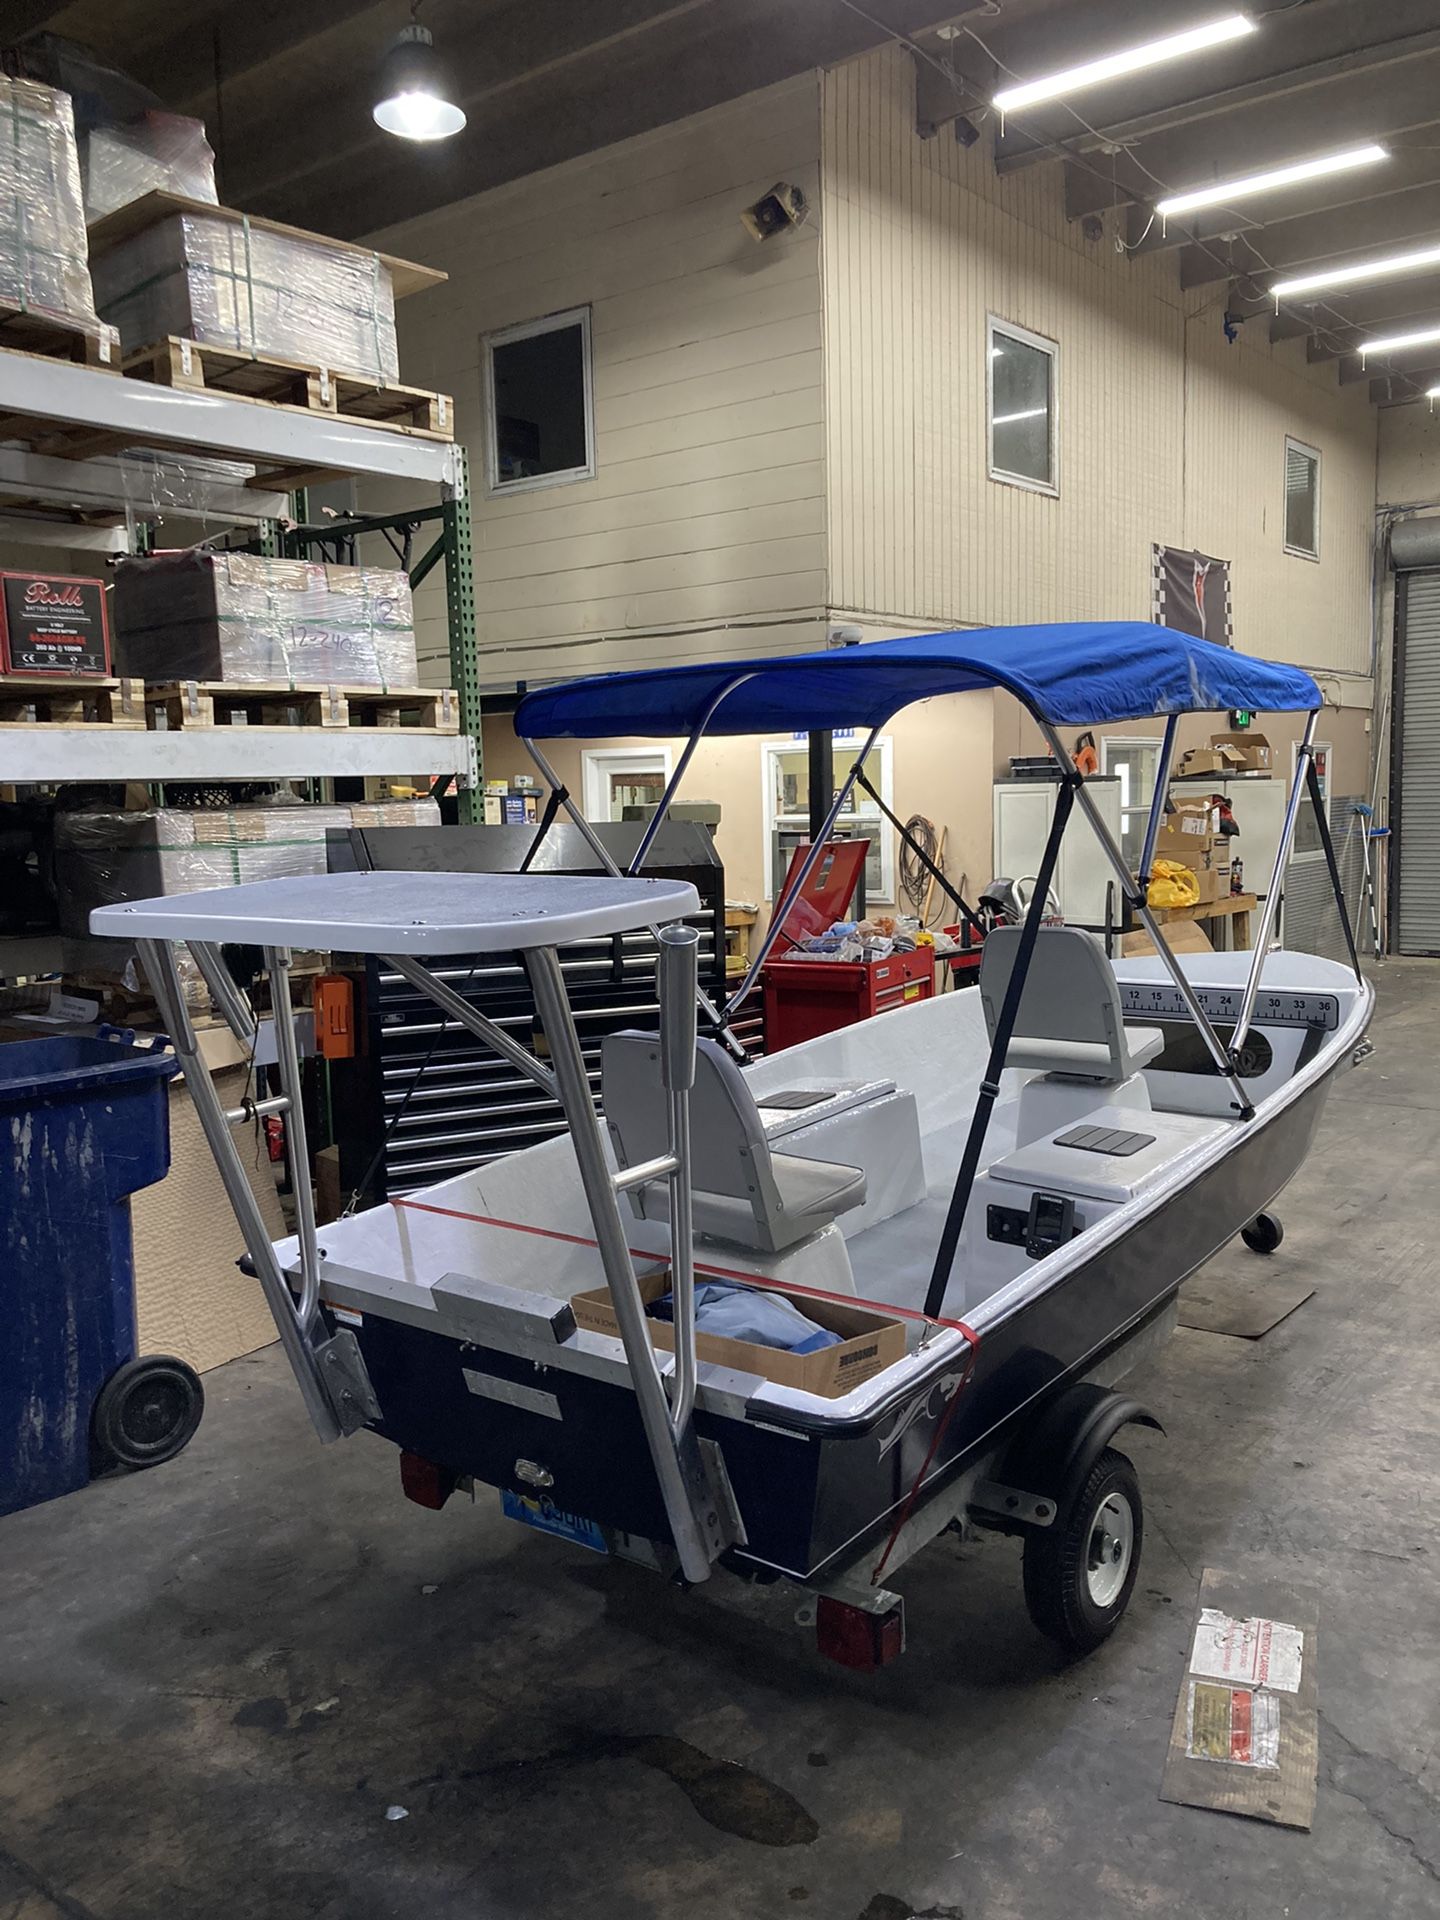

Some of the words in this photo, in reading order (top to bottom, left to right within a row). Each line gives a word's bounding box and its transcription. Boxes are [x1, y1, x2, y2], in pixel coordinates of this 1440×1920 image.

[24, 582, 84, 606] Rolls
[49, 606, 85, 615] ENGINEERING
[1128, 990, 1140, 999] 12
[1151, 991, 1162, 1001] 15
[1198, 994, 1208, 1003] 21
[1220, 995, 1232, 1005] 24
[1268, 998, 1281, 1007] 30
[1293, 1000, 1306, 1009] 33
[1318, 1001, 1331, 1011] 36
